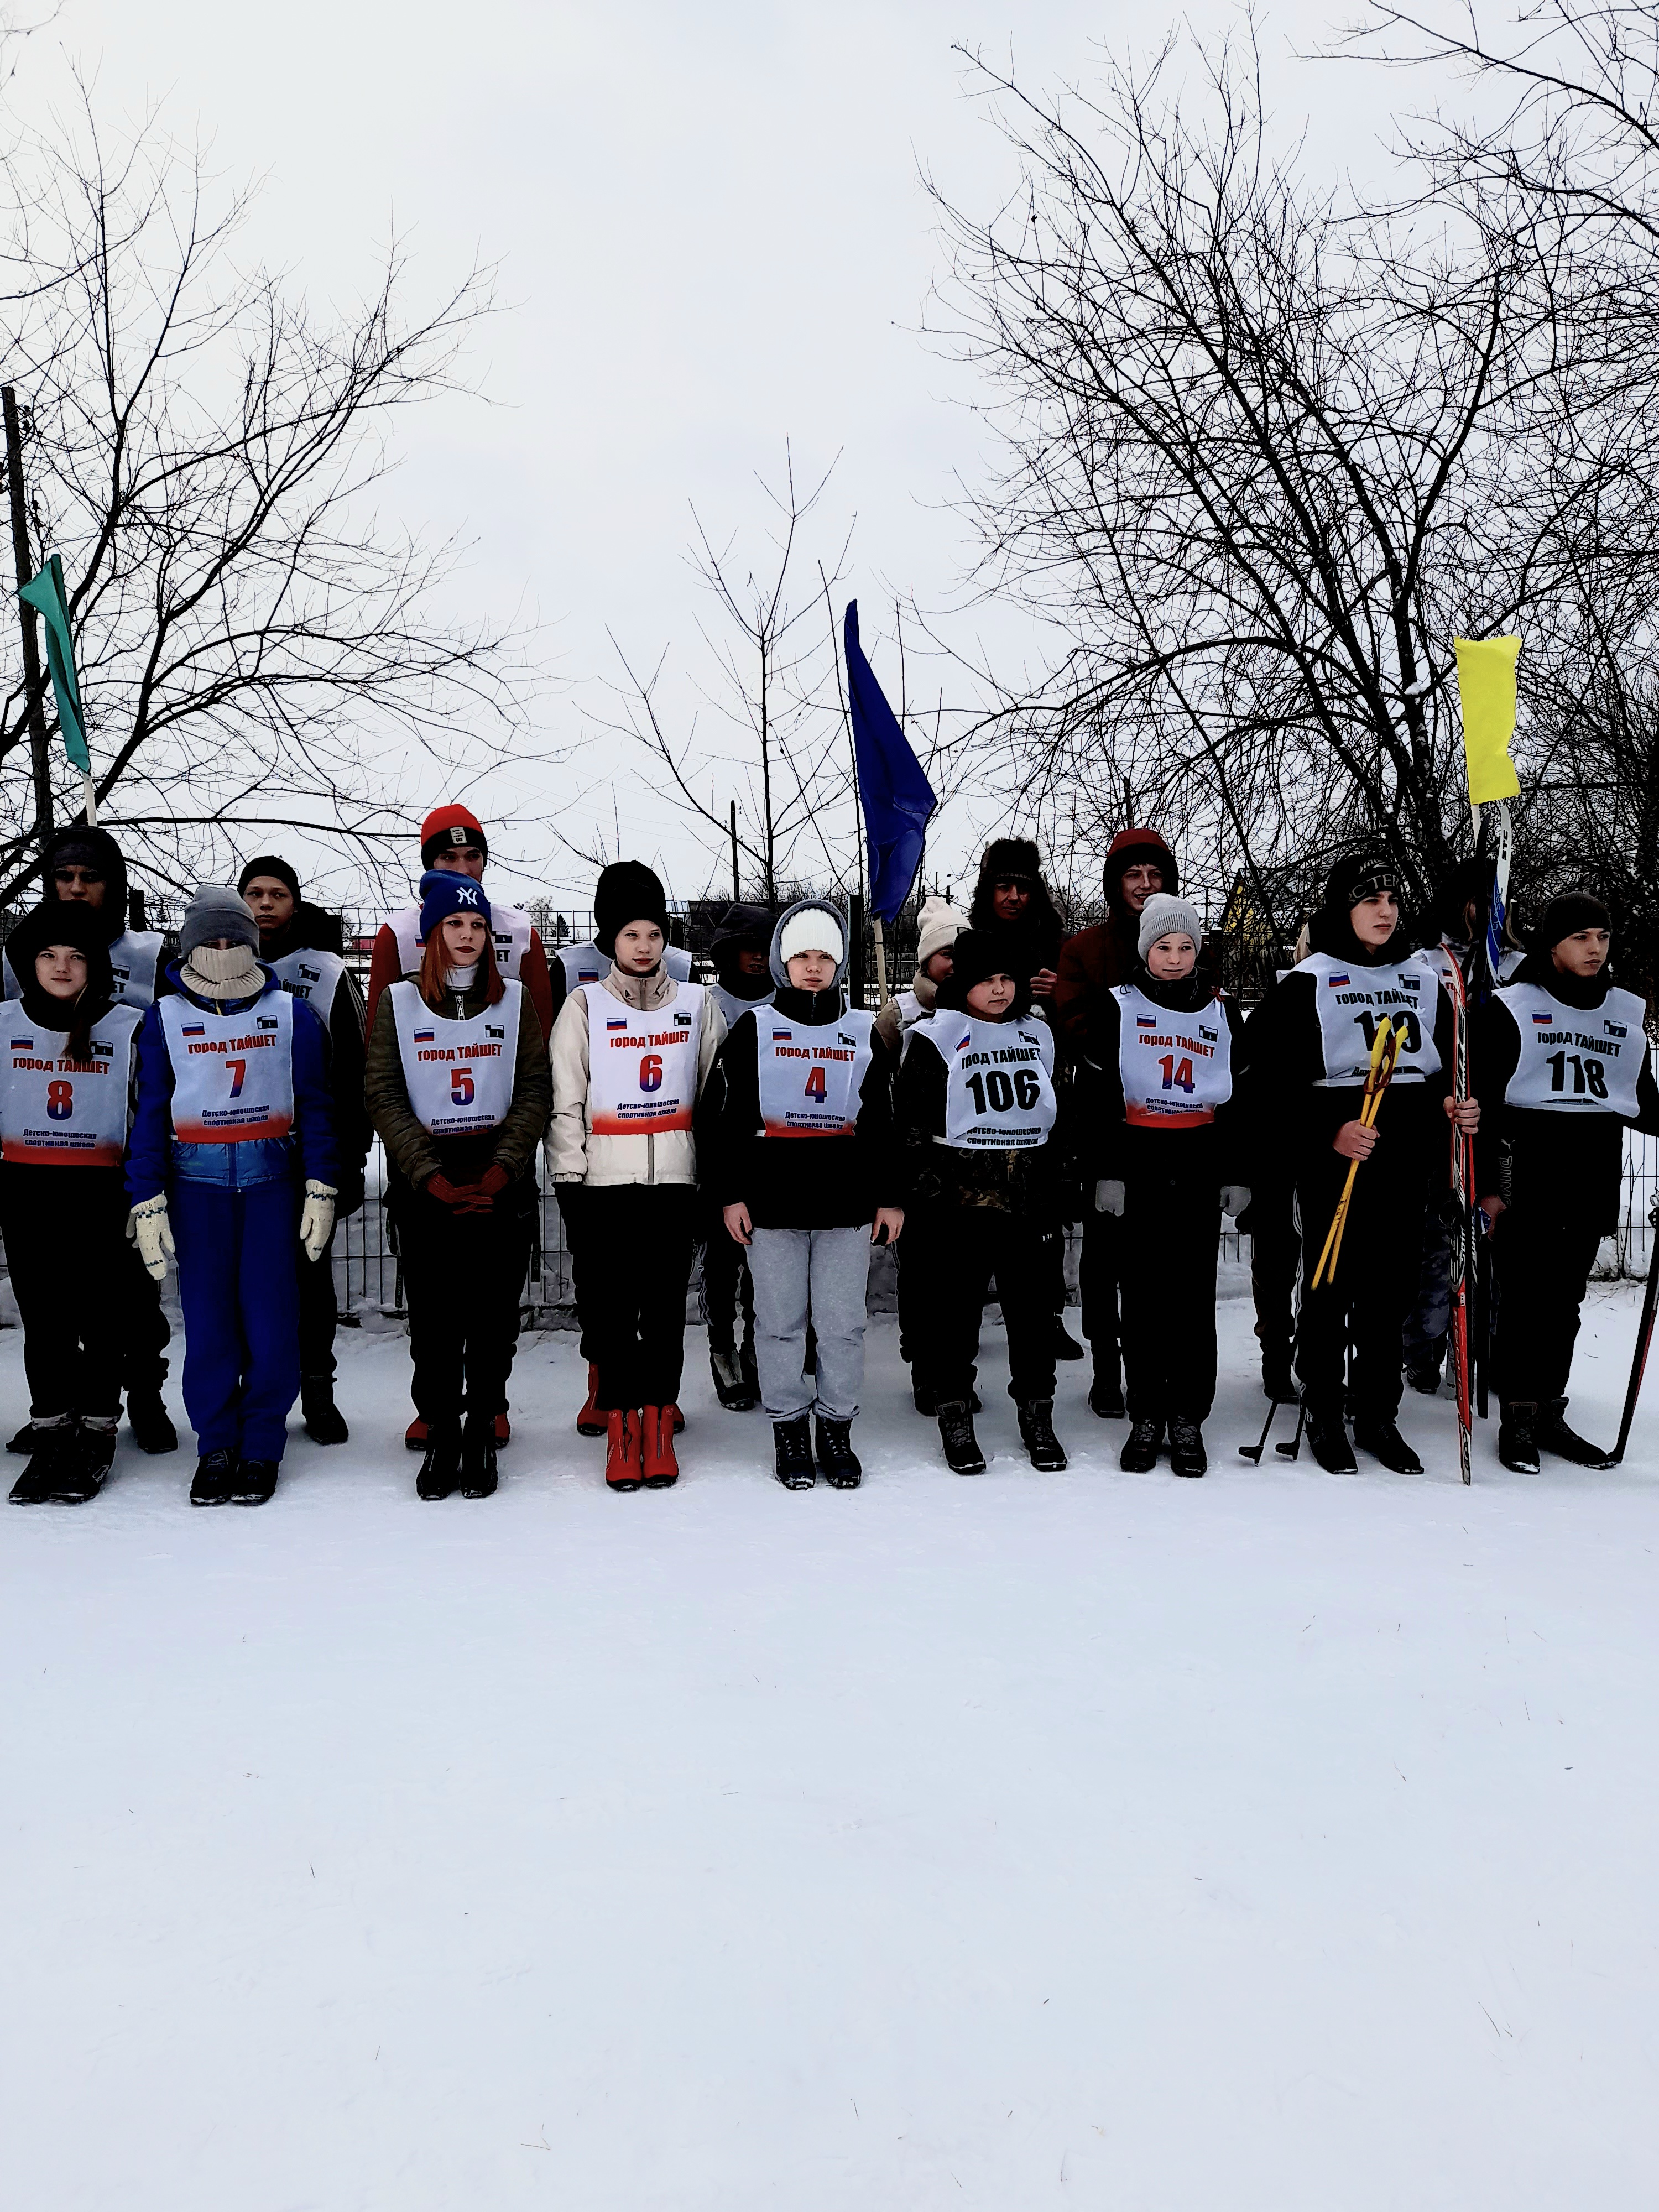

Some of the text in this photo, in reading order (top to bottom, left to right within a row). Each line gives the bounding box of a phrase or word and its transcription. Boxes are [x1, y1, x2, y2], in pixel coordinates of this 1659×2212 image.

[456, 886, 478, 906] NY
[1493, 886, 1503, 931] CLASSIC
[188, 1034, 277, 1054] город ТАЙШЕТ
[611, 1031, 690, 1048] город ТАЙШЕТ
[1139, 1034, 1215, 1058] город ТАЙШЕТ
[1574, 1032, 1622, 1057] ТАЙШЕТ
[418, 1042, 502, 1061] город ТАЙШЕТ
[775, 1046, 855, 1061] город ТАЙШЕТ
[991, 1046, 1040, 1063] ТАЙШЕТ
[13, 1057, 110, 1075] город ТАЙШЕТ
[639, 1054, 663, 1092] 6
[1158, 1054, 1196, 1094] 14
[1546, 1050, 1609, 1099] 118
[225, 1058, 246, 1098] 7
[451, 1067, 474, 1106] 5
[805, 1066, 827, 1103] 4
[46, 1079, 74, 1121] 8
[965, 1068, 1040, 1115] 106
[201, 1105, 270, 1118] Детско-юношеская
[617, 1098, 680, 1110] Детско-юношеская
[204, 1118, 245, 1126] спортивная
[431, 1114, 495, 1126] Детско-юношеская
[617, 1110, 656, 1119] спортивная
[785, 1112, 846, 1121] Детско-юношеская
[23, 1128, 97, 1139] Детско-юношеская
[432, 1125, 472, 1134] спортивная
[24, 1139, 69, 1147] спортивная
[967, 1137, 1015, 1146] спортивная
